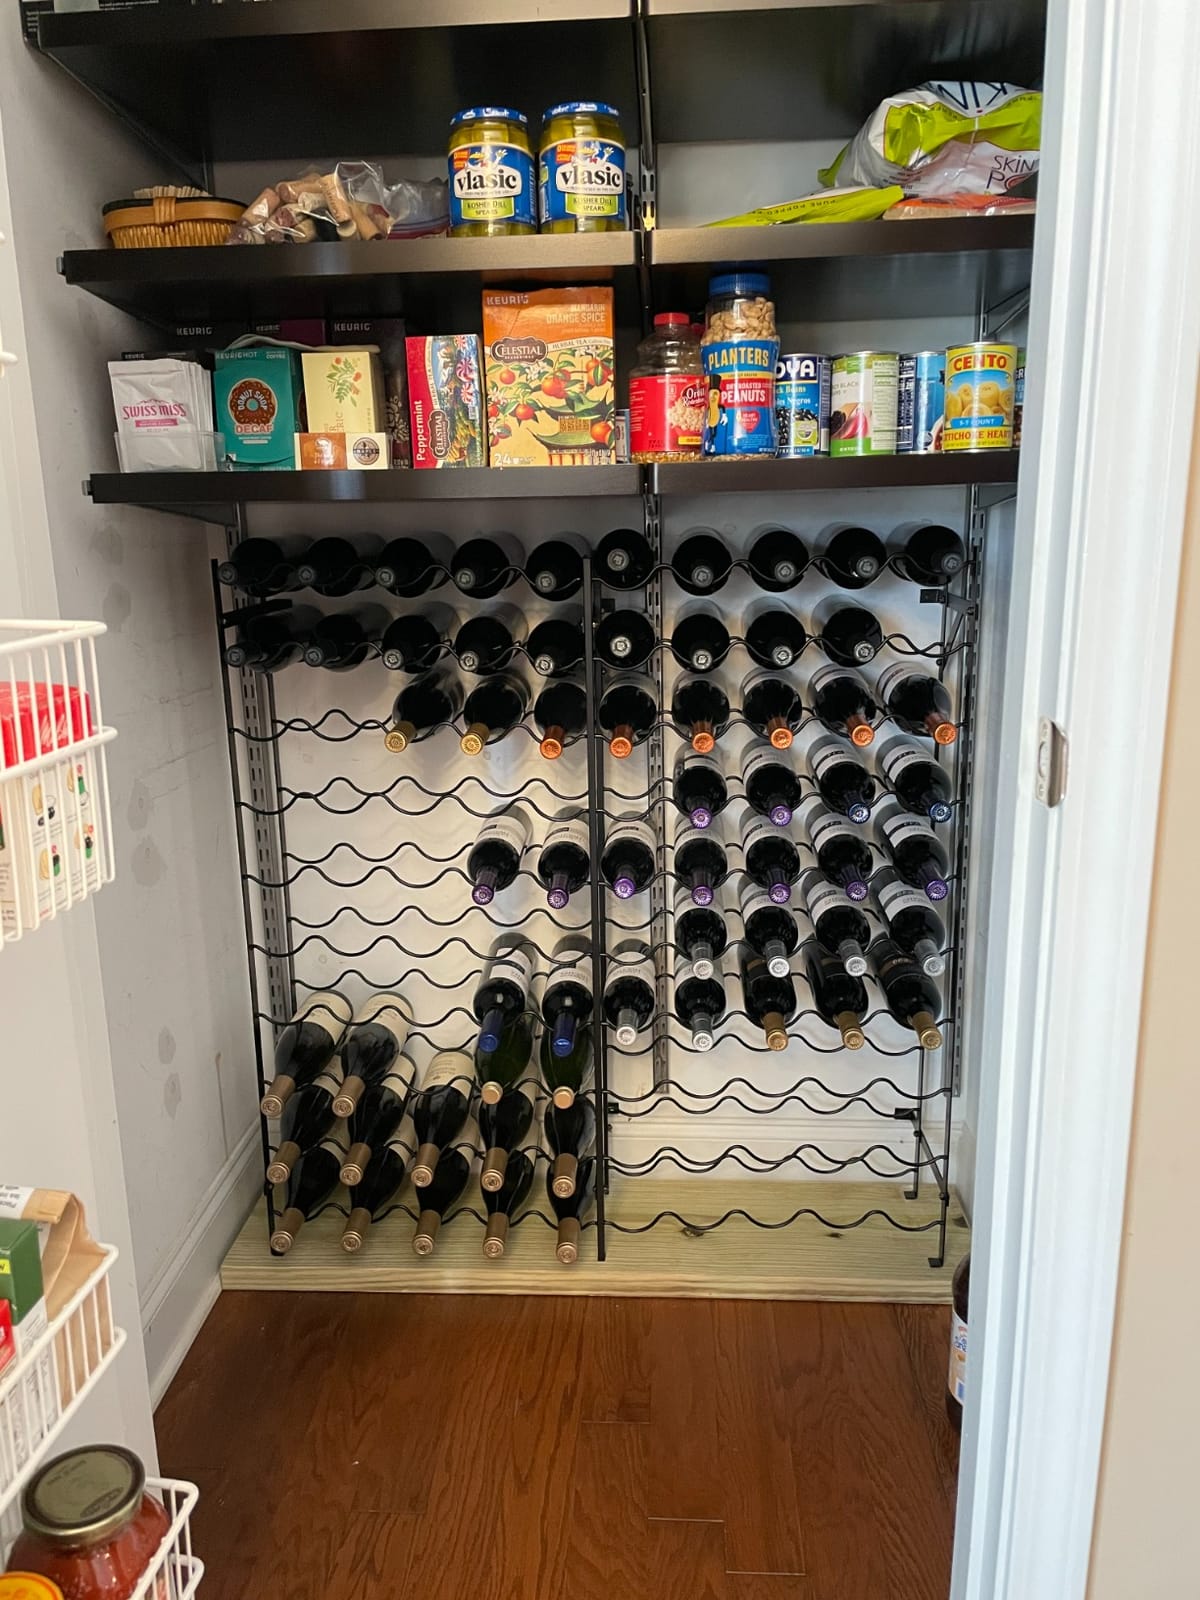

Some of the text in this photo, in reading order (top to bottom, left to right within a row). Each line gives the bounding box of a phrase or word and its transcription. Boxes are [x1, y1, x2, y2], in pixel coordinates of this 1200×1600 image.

[457, 168, 517, 191] vlasic
[561, 166, 621, 188] vlasic
[487, 294, 529, 306] KEURIG
[546, 311, 606, 325] ORANGE SPICE
[176, 326, 213, 336] KEURIG
[334, 322, 370, 332] KEURIG
[495, 344, 543, 358] CELESTIAL
[708, 346, 769, 372] PLANTERS
[776, 360, 816, 379] OYA
[953, 354, 1008, 372] CENTO
[237, 389, 269, 412] DONUT SHOP
[721, 389, 766, 404] PEANUTS
[122, 403, 187, 420] SWISS MISS
[235, 424, 274, 434] DECAF
[414, 399, 427, 461] Peppermint
[434, 414, 446, 456] CELESTIAL
